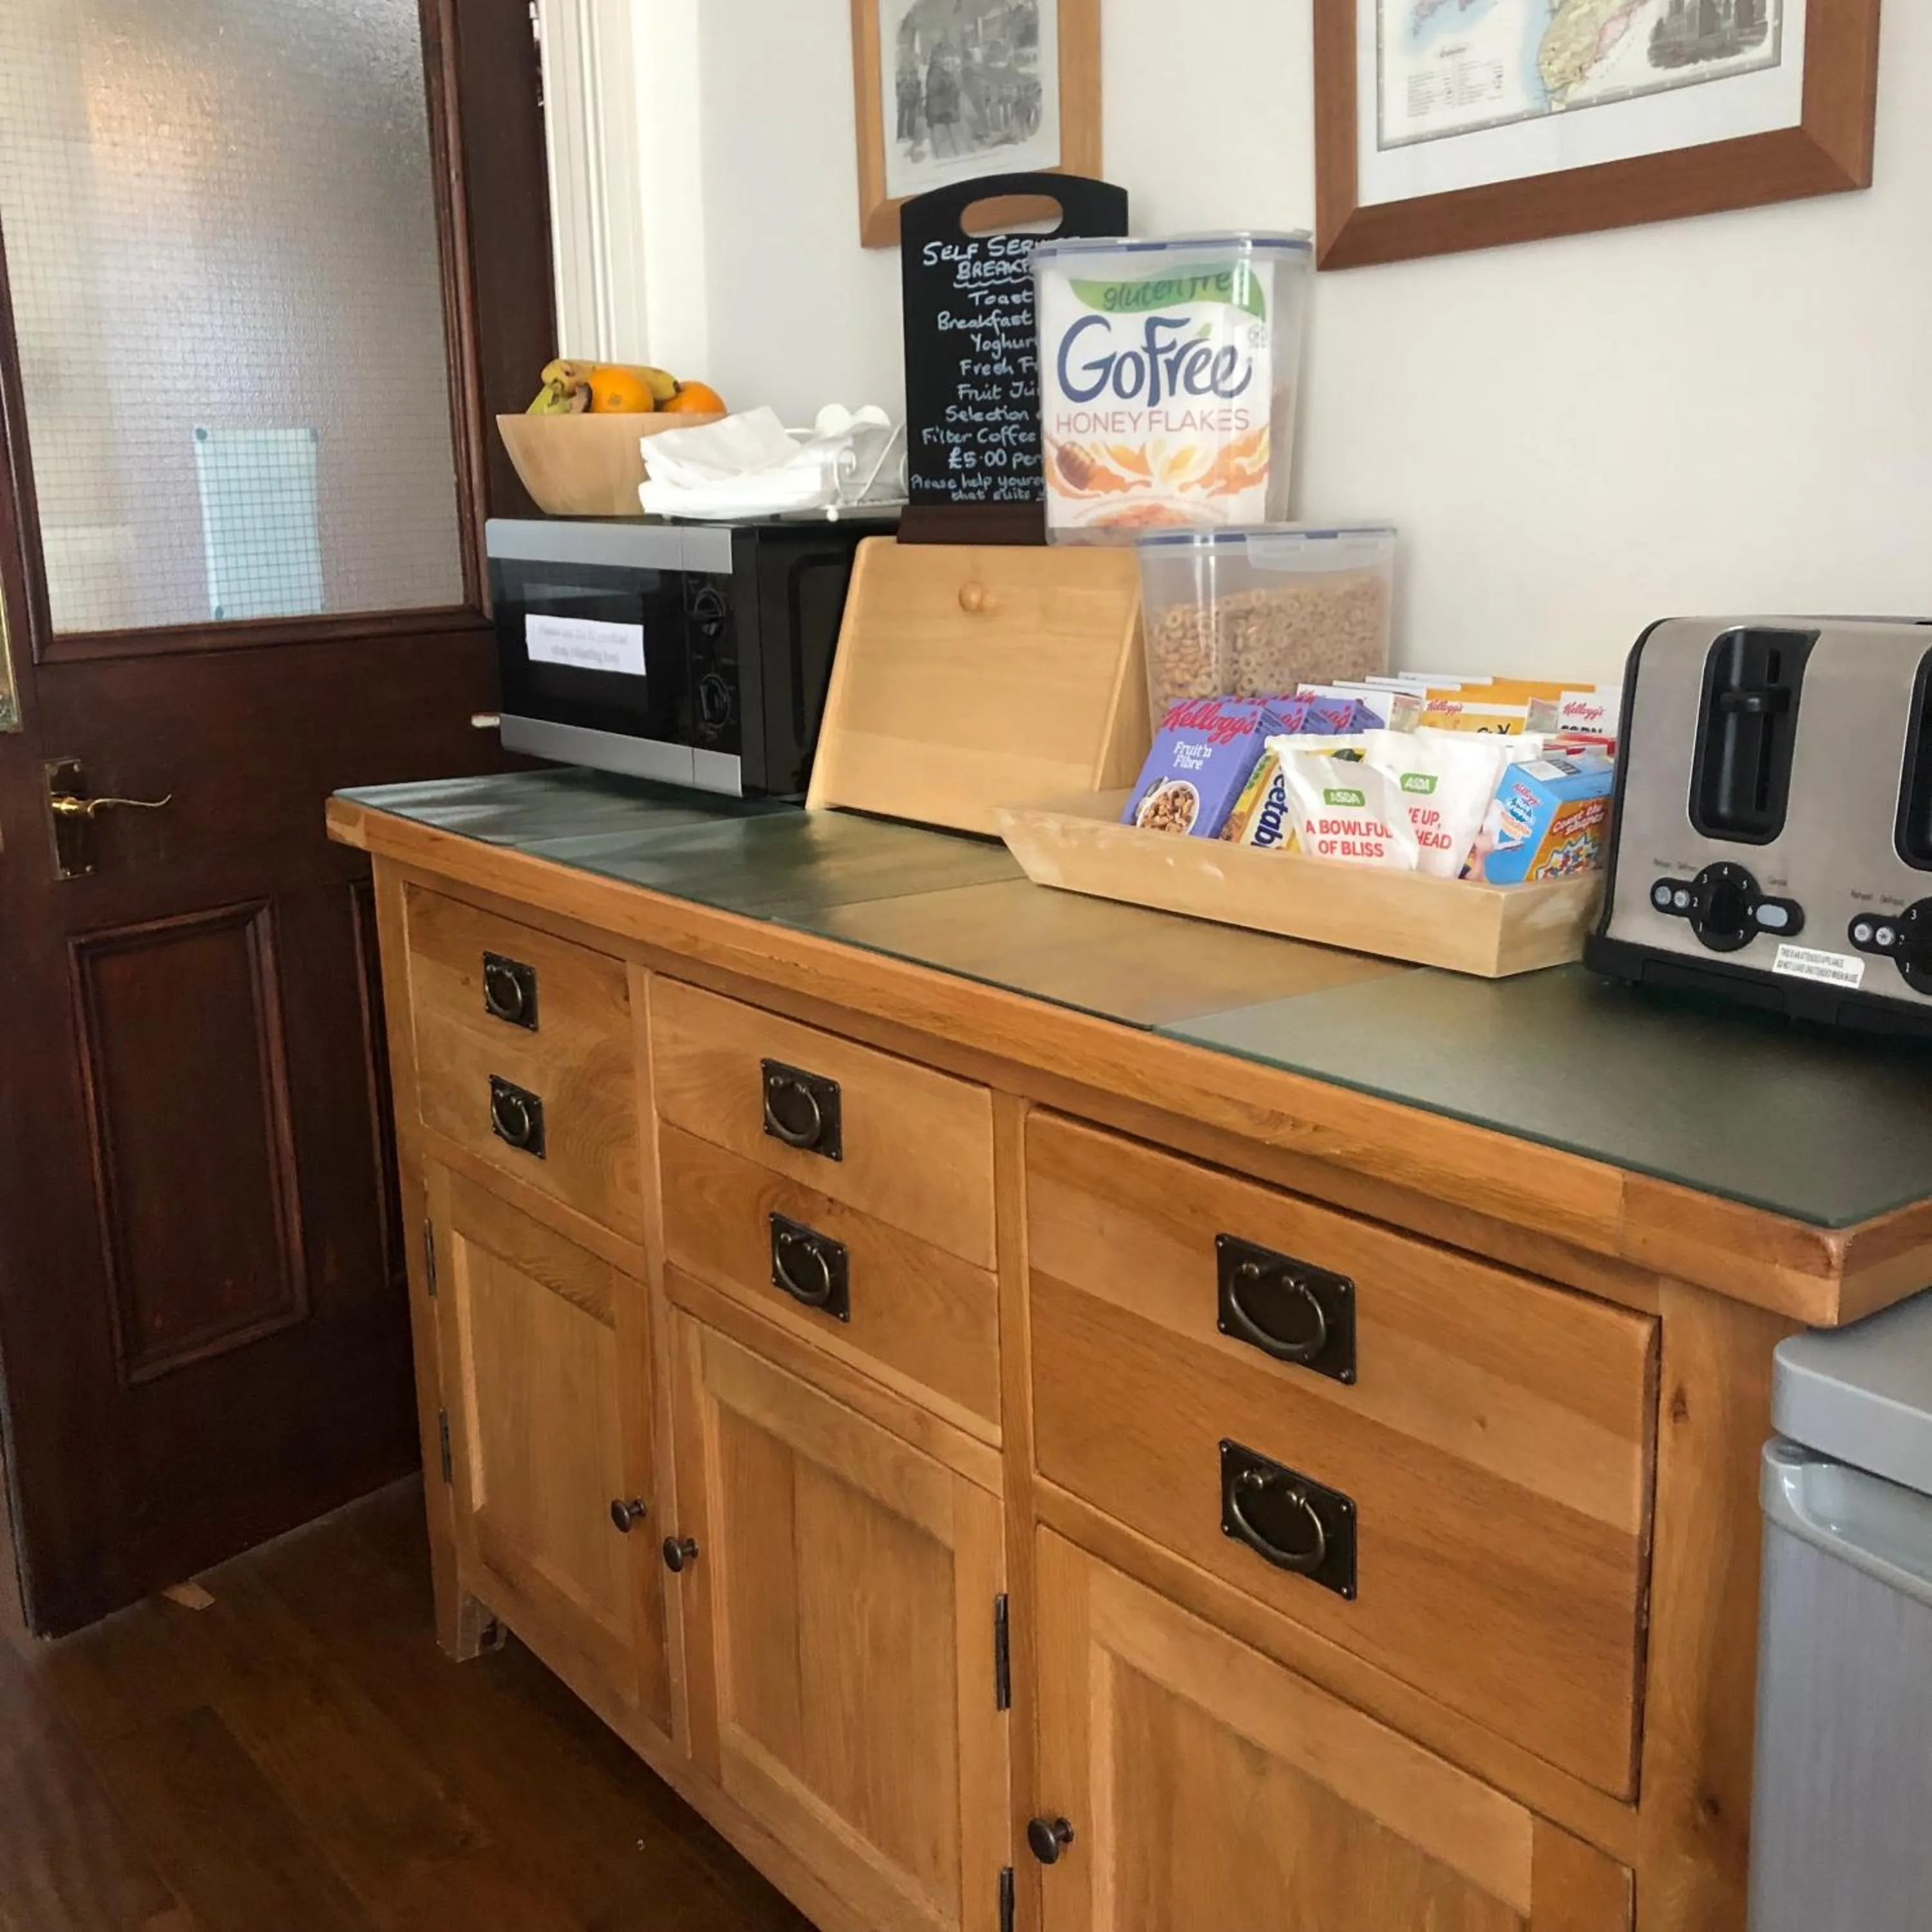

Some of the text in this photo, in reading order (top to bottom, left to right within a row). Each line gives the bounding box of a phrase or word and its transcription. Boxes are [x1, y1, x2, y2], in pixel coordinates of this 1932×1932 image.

[923, 242, 979, 265] SELF
[956, 259, 1033, 279] BREAKF
[968, 290, 1034, 305] Toast
[1103, 276, 1185, 310] gluten
[937, 309, 1033, 335] Breakfast
[970, 332, 1038, 359] Yoghur
[960, 357, 1014, 376] Fresh
[1057, 314, 1251, 407] GoFree
[957, 381, 1040, 401] Fruit Jui
[945, 404, 1030, 423] Selection
[1056, 412, 1142, 433] HONEY
[1148, 408, 1250, 431] FLAKES
[922, 424, 1037, 446] Filter Coffee
[961, 471, 992, 489] help
[951, 488, 985, 501] that
[1562, 701, 1605, 720] Kellogg's
[1162, 699, 1258, 744] Kellogg's
[1171, 755, 1204, 771] Fibre
[1330, 791, 1360, 804] ASDA
[1421, 808, 1441, 829] UP,
[1306, 820, 1394, 838] A BOWLFUL
[1319, 840, 1385, 858] OF BLISS
[1723, 867, 1728, 876] 4
[1692, 897, 1698, 907] 2
[1910, 909, 1917, 921] 3
